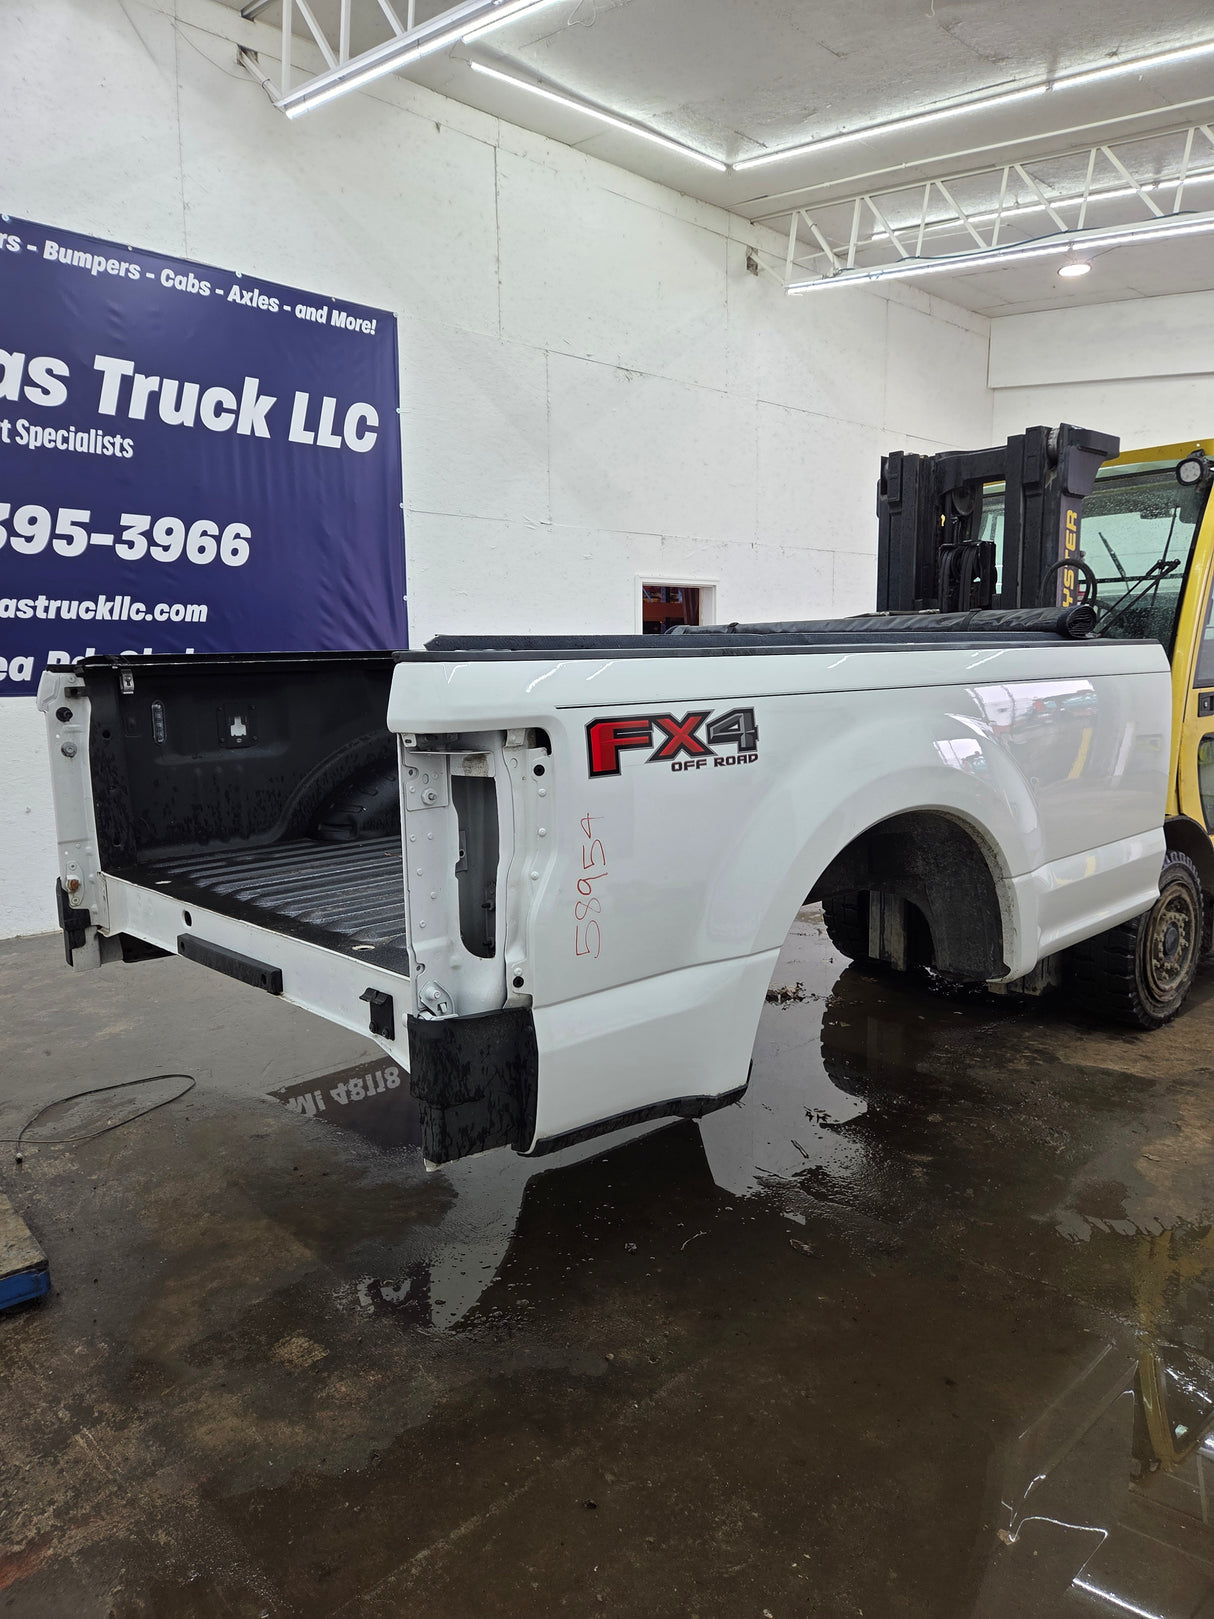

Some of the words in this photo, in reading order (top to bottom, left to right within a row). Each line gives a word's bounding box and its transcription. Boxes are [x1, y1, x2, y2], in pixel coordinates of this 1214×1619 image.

[43, 240, 141, 280] Bumpers
[160, 268, 211, 297] Cabs
[227, 284, 280, 313] Axles
[294, 304, 328, 325] and
[330, 310, 377, 336] More!
[0, 418, 12, 444] t
[15, 418, 135, 459] Specialists
[94, 354, 277, 439] Truck
[288, 391, 380, 453] LLC
[584, 706, 759, 780] FX4
[671, 758, 707, 773] OFF
[713, 752, 759, 768] ROAD
[575, 812, 609, 959] 58954
